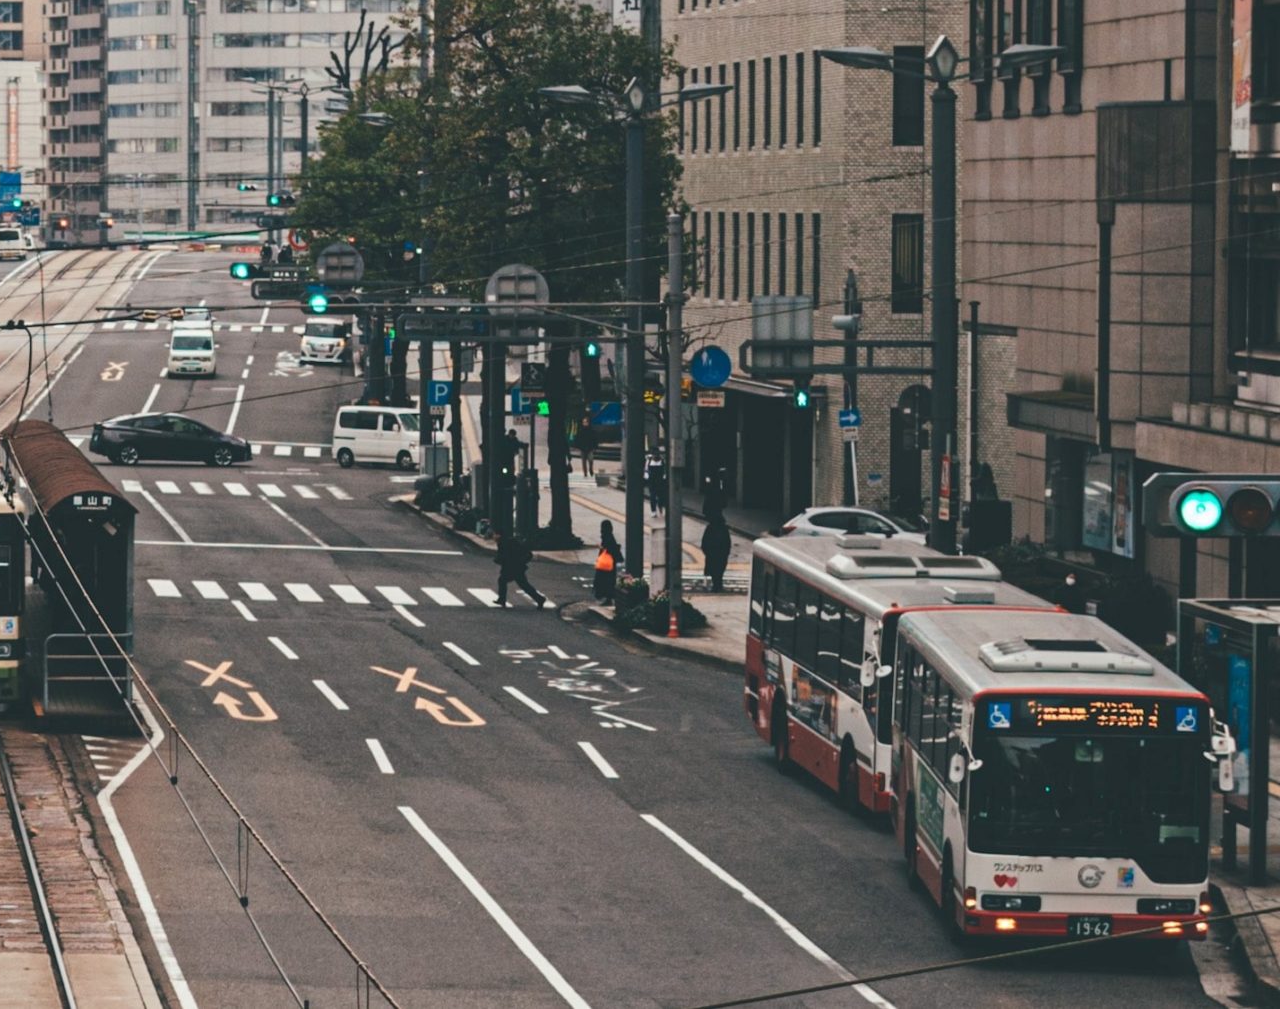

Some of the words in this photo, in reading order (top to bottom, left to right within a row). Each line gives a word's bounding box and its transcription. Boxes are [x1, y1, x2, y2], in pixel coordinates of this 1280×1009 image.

[435, 384, 449, 402] P
[993, 862, 1044, 874] ワンステップバス
